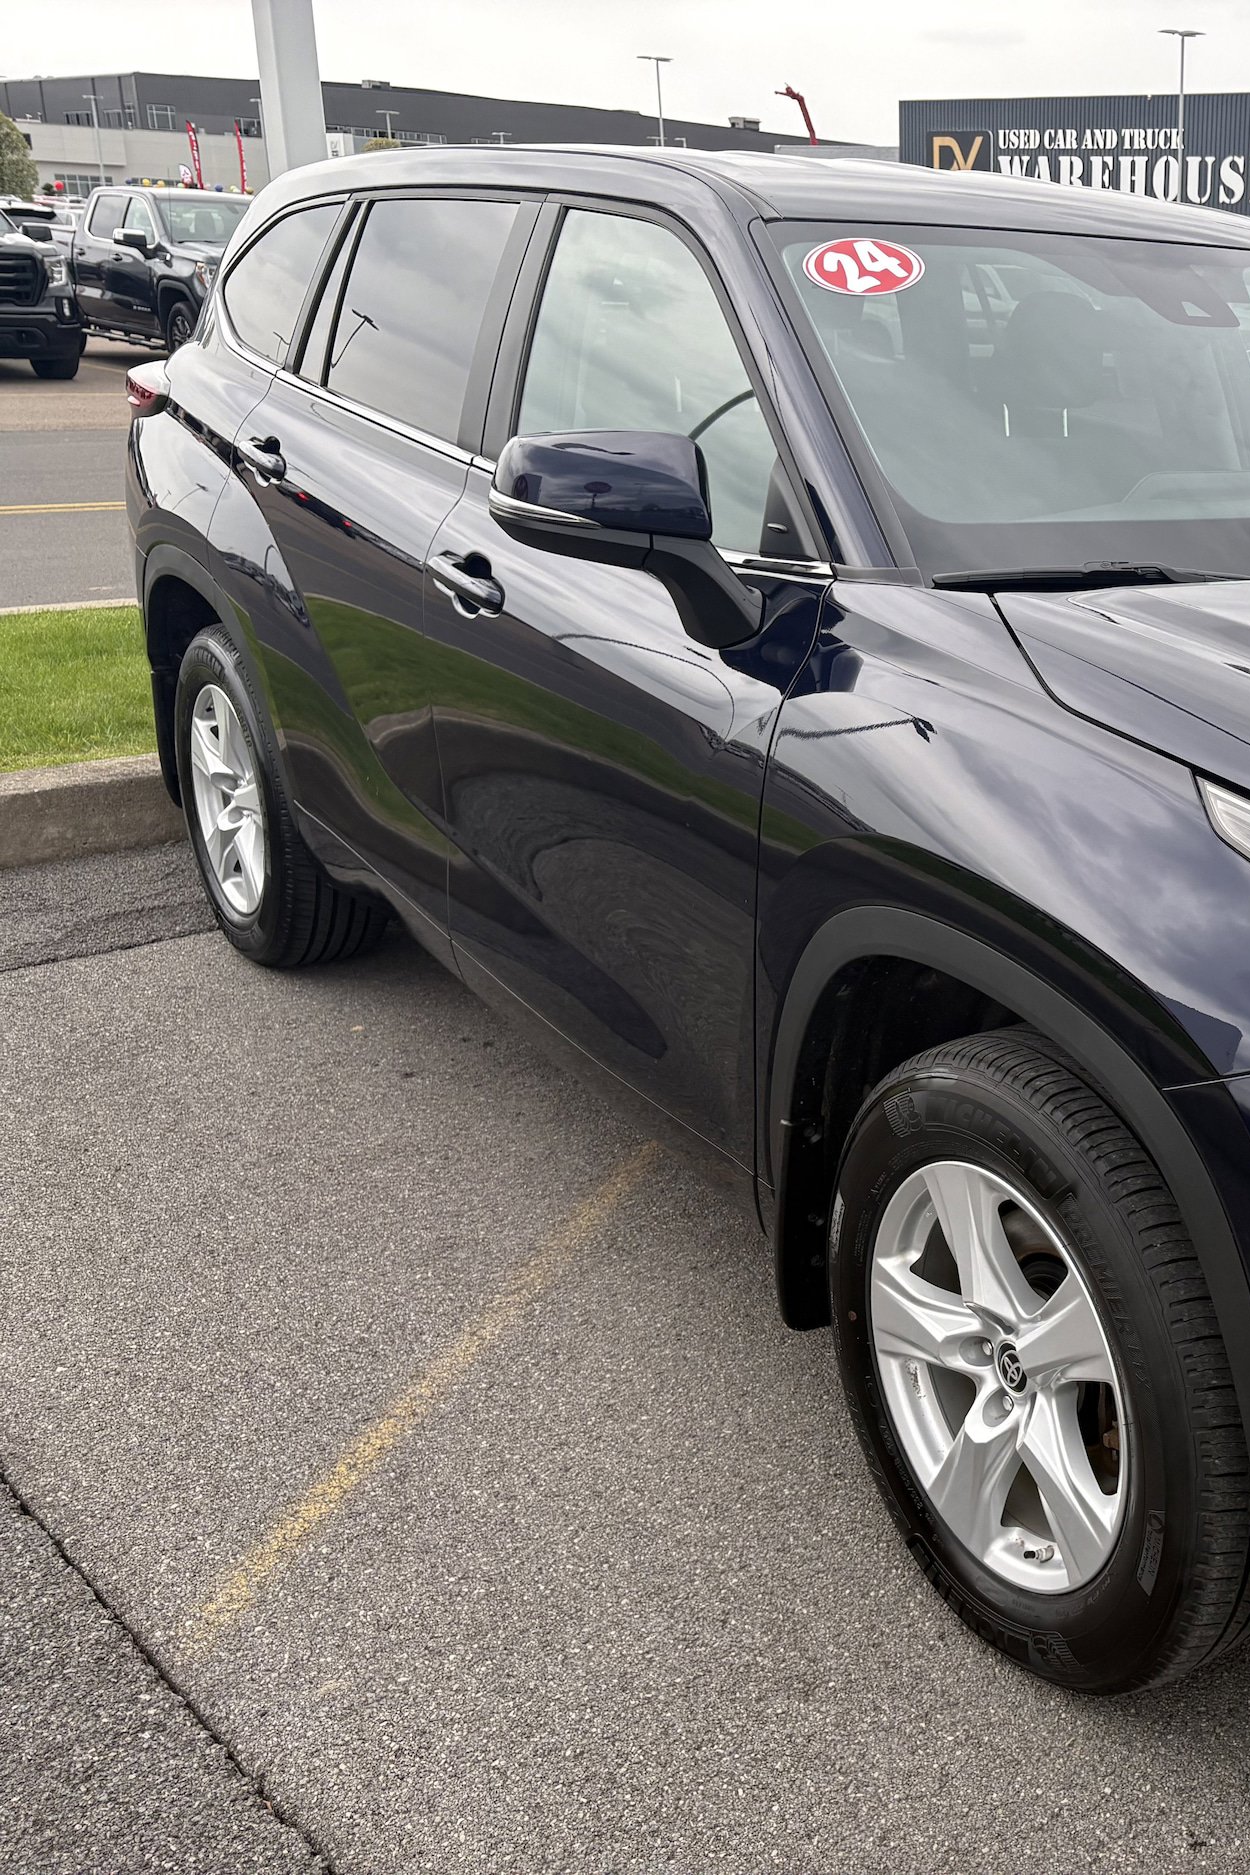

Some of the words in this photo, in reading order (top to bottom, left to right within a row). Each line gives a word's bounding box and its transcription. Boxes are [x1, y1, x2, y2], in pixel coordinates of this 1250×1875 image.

[998, 128, 1041, 150] USED
[1043, 128, 1079, 150] CAR
[1081, 128, 1118, 150] AND
[1121, 128, 1185, 150] TRUCK
[823, 241, 910, 292] 24
